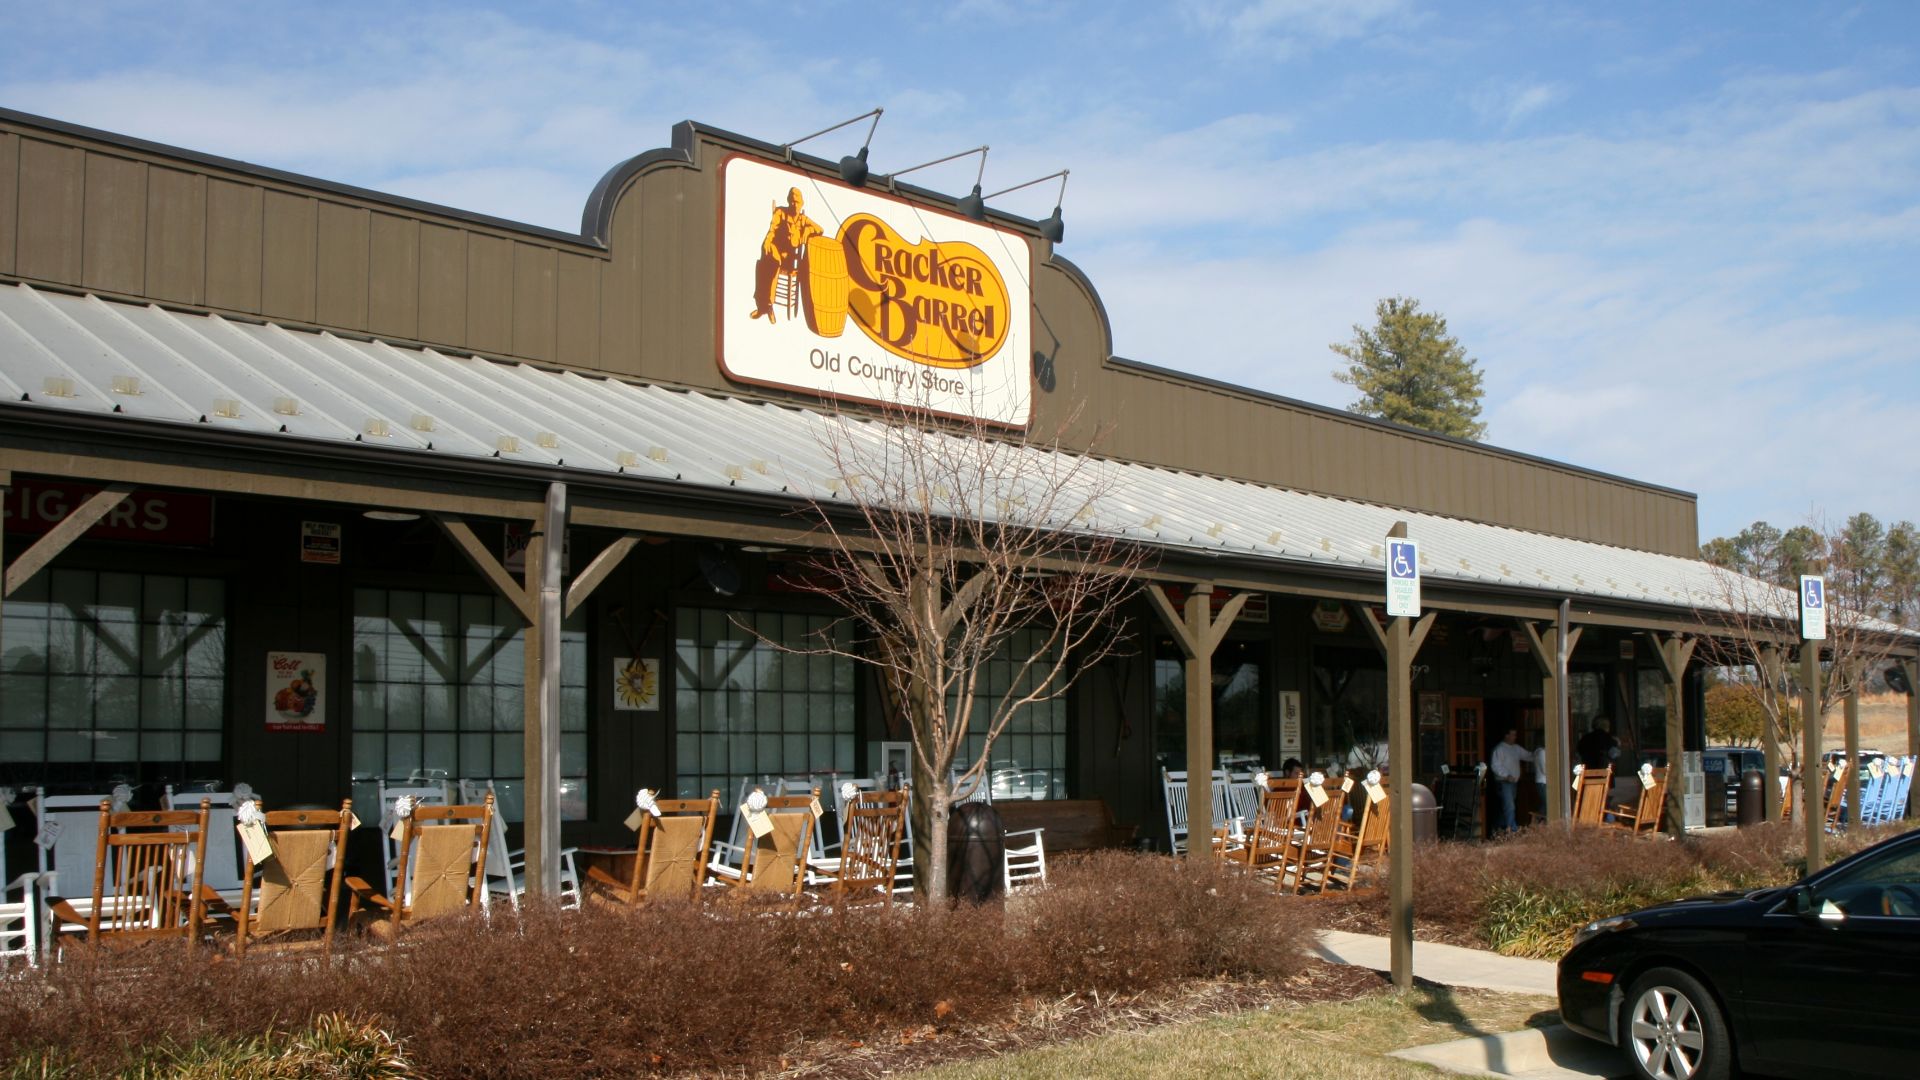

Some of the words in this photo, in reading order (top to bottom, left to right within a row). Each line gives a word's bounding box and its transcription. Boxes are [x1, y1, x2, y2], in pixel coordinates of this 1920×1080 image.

[809, 348, 840, 373] Old
[848, 355, 917, 389] Country
[921, 369, 965, 396] Store
[4, 486, 169, 531] IGRS
